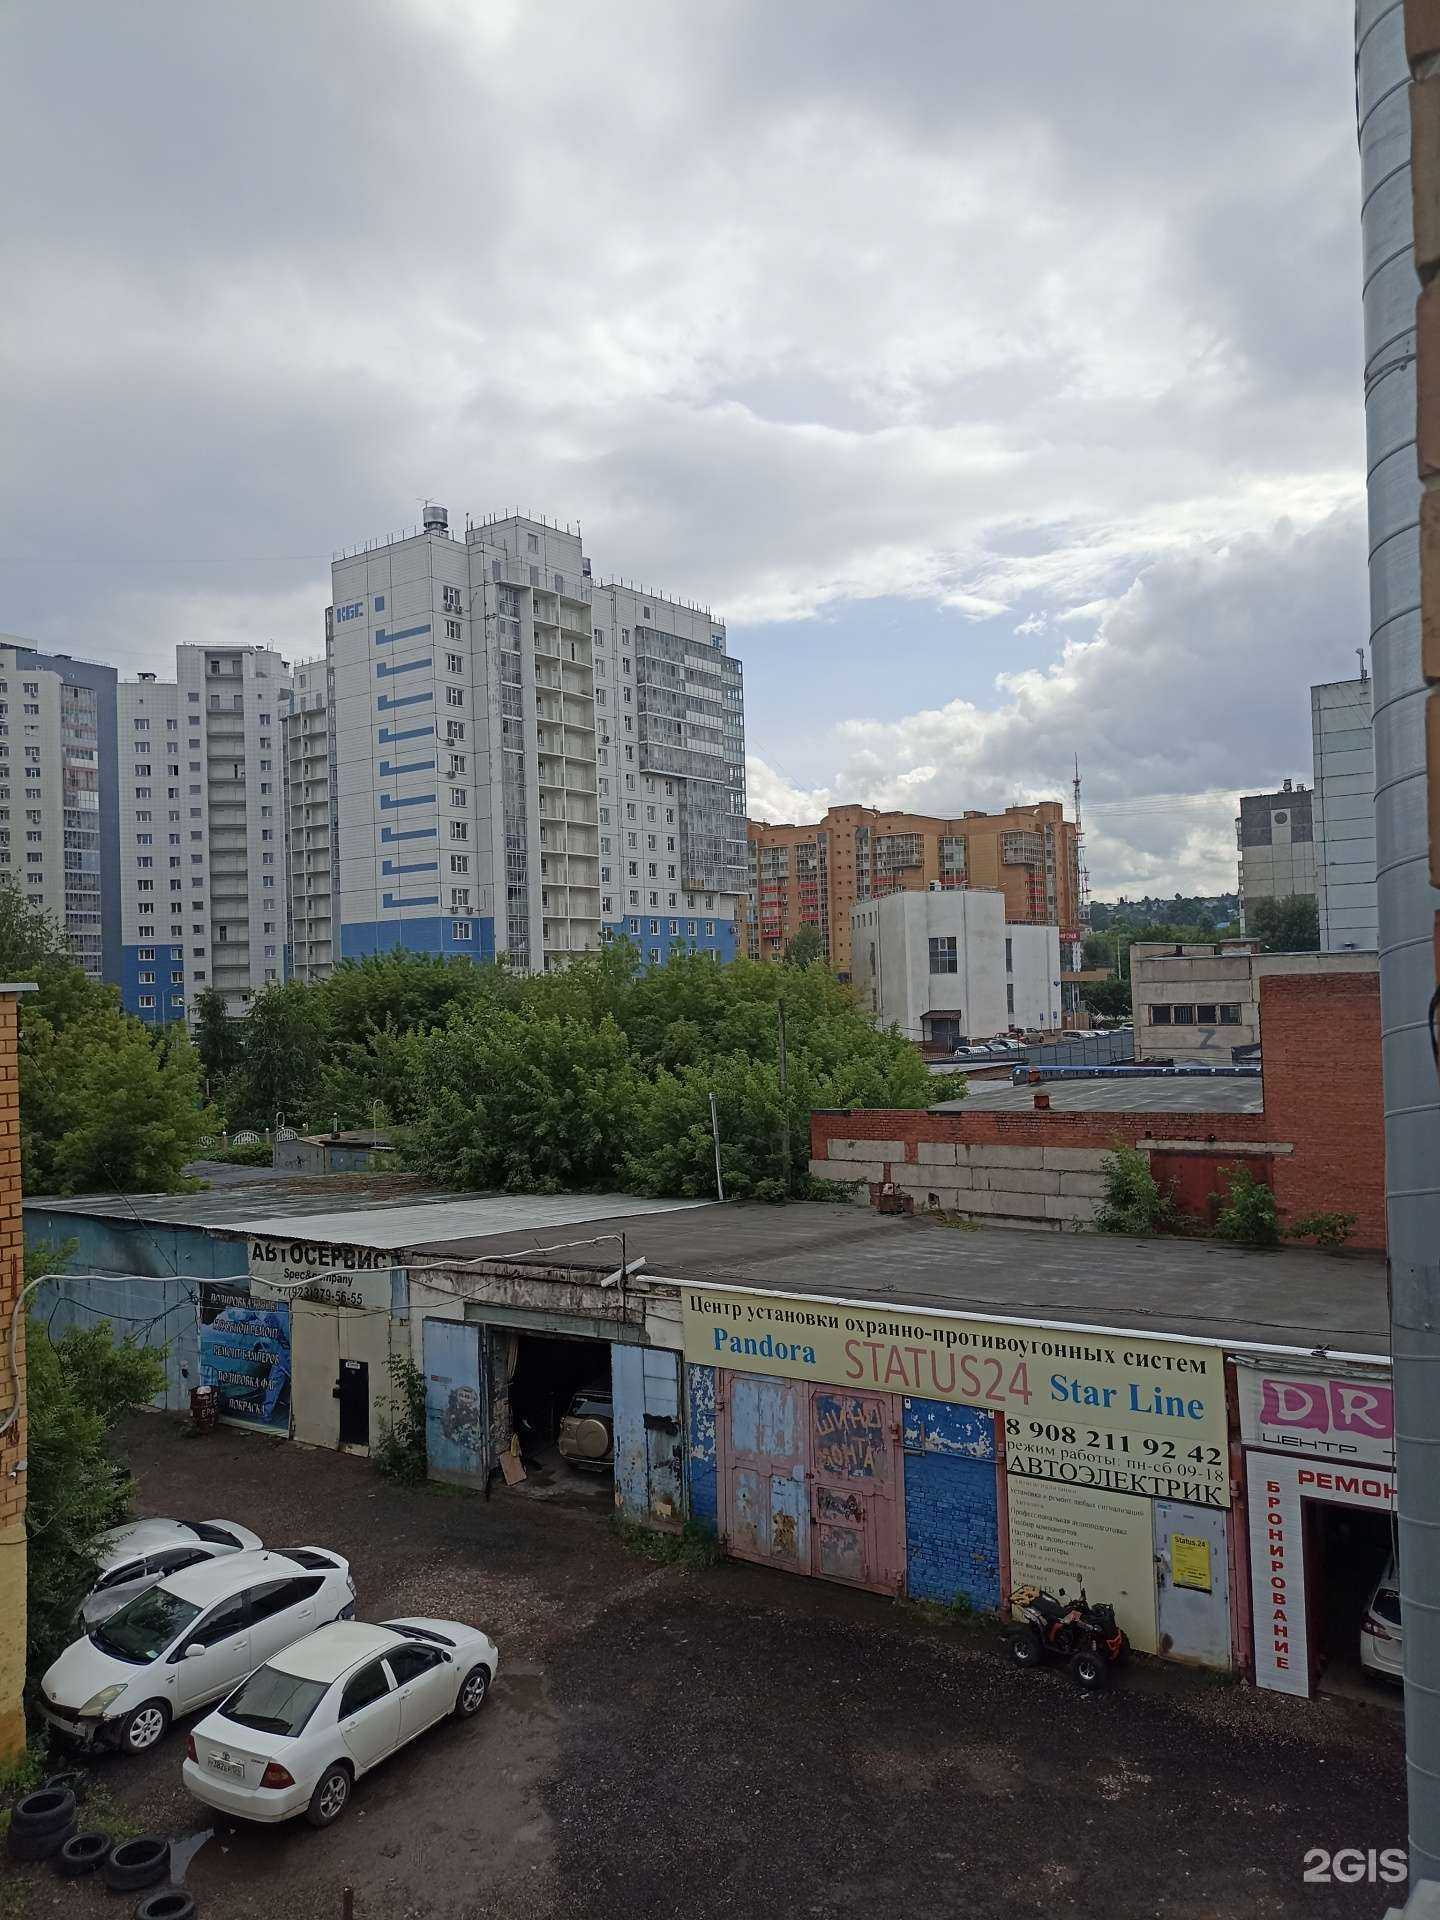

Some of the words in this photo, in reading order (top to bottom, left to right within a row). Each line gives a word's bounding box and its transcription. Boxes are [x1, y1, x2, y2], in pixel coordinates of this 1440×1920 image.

[251, 1240, 387, 1270] АВТОСЕРВИС
[690, 1295, 742, 1317] Центр
[748, 1306, 839, 1329] установки
[844, 1317, 1115, 1365] охранно-противоугонных
[1123, 1350, 1207, 1375] систем
[713, 1327, 817, 1364] Pandora
[843, 1339, 1033, 1405] STATUS24
[1050, 1373, 1117, 1409] Star
[1128, 1382, 1205, 1420] Line
[1006, 1418, 1021, 1436] 8
[1029, 1421, 1077, 1445] 908
[1086, 1430, 1130, 1453] 211
[1142, 1438, 1176, 1460] 92
[1187, 1445, 1222, 1466] 42
[1007, 1440, 1056, 1457] режим
[1126, 1459, 1173, 1475] пн-сб
[1177, 1464, 1224, 1484] 09-18
[1262, 1432, 1358, 1454] ЦЕНТР
[1009, 1455, 1224, 1505] АВТОЭЛЕКТРИК
[1266, 1480, 1290, 1670] БРОНИРОВАНИЕ
